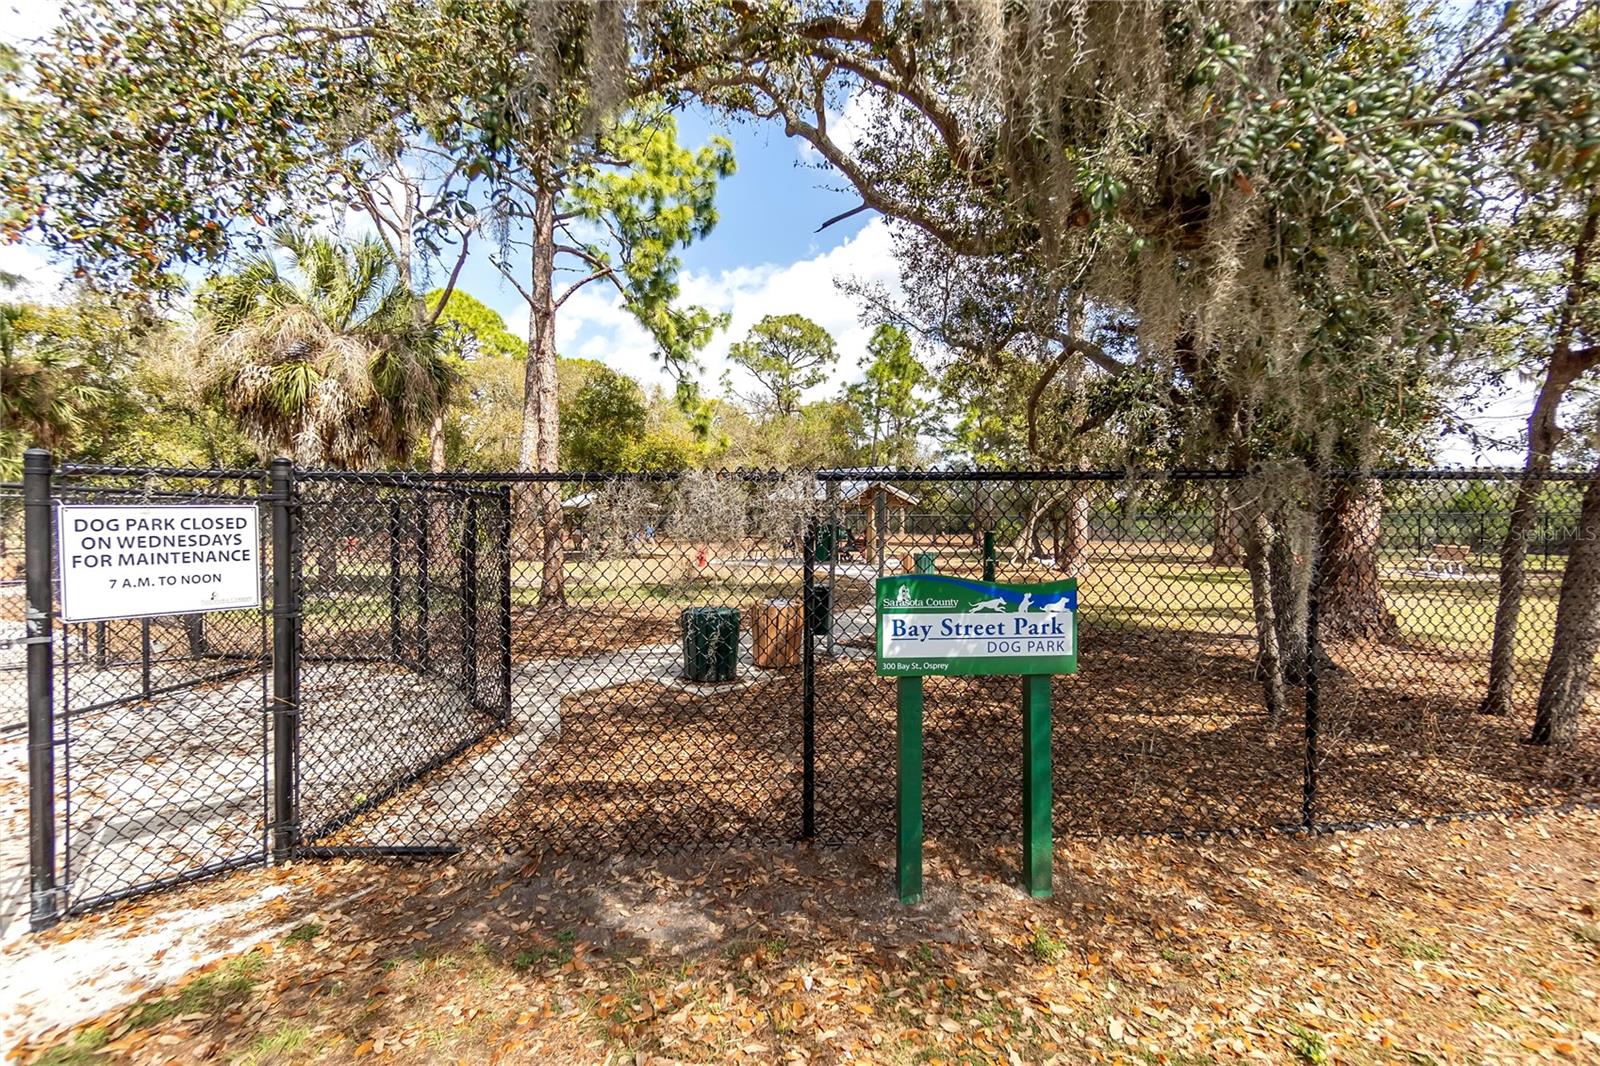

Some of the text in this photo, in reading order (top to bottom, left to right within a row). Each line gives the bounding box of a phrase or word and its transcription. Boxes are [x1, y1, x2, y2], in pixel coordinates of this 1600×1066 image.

[74, 517, 247, 532] DOG PARK CLOSED
[81, 534, 242, 550] ON WEDNESDAYS
[72, 549, 251, 568] FOR MAINTENANCE
[109, 573, 222, 589] 7 A.M. TO NOON
[883, 597, 959, 608] Sarasota County
[892, 616, 1065, 642] Bay Street Park
[987, 640, 1065, 653] DOG PARK
[897, 663, 910, 671] Bay
[923, 662, 949, 671] Osprey
